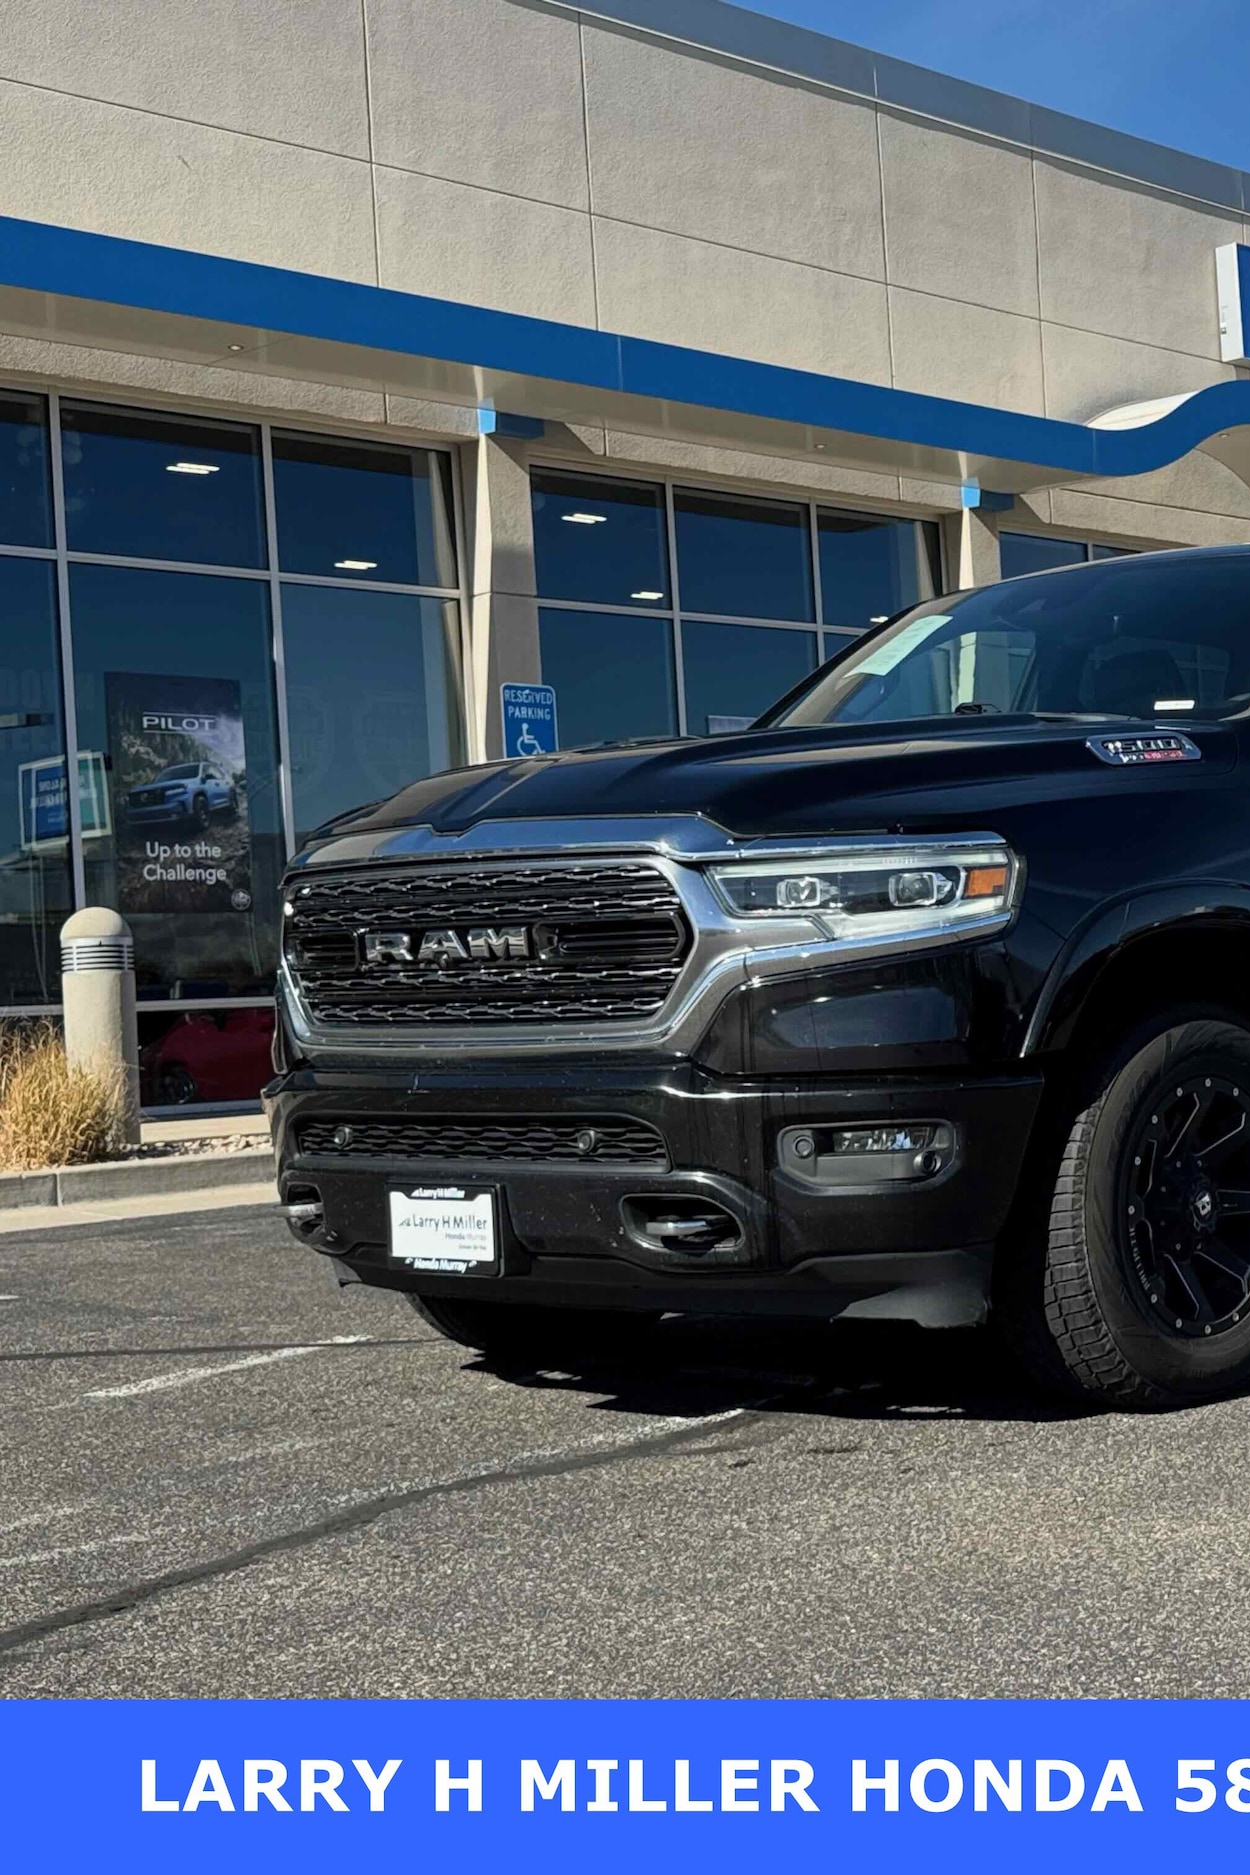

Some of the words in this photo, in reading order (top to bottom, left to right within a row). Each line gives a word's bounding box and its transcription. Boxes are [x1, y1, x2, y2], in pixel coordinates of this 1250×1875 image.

[504, 689, 553, 705] RESERVED
[507, 705, 551, 720] PARKING
[142, 716, 216, 731] PILOT
[146, 842, 170, 861] Up
[174, 842, 192, 858] to
[195, 842, 222, 858] the
[143, 864, 227, 885] Challenge
[365, 927, 529, 961] RAM
[413, 1214, 439, 1231] Larry
[442, 1215, 451, 1229] H
[453, 1214, 487, 1229] Miller
